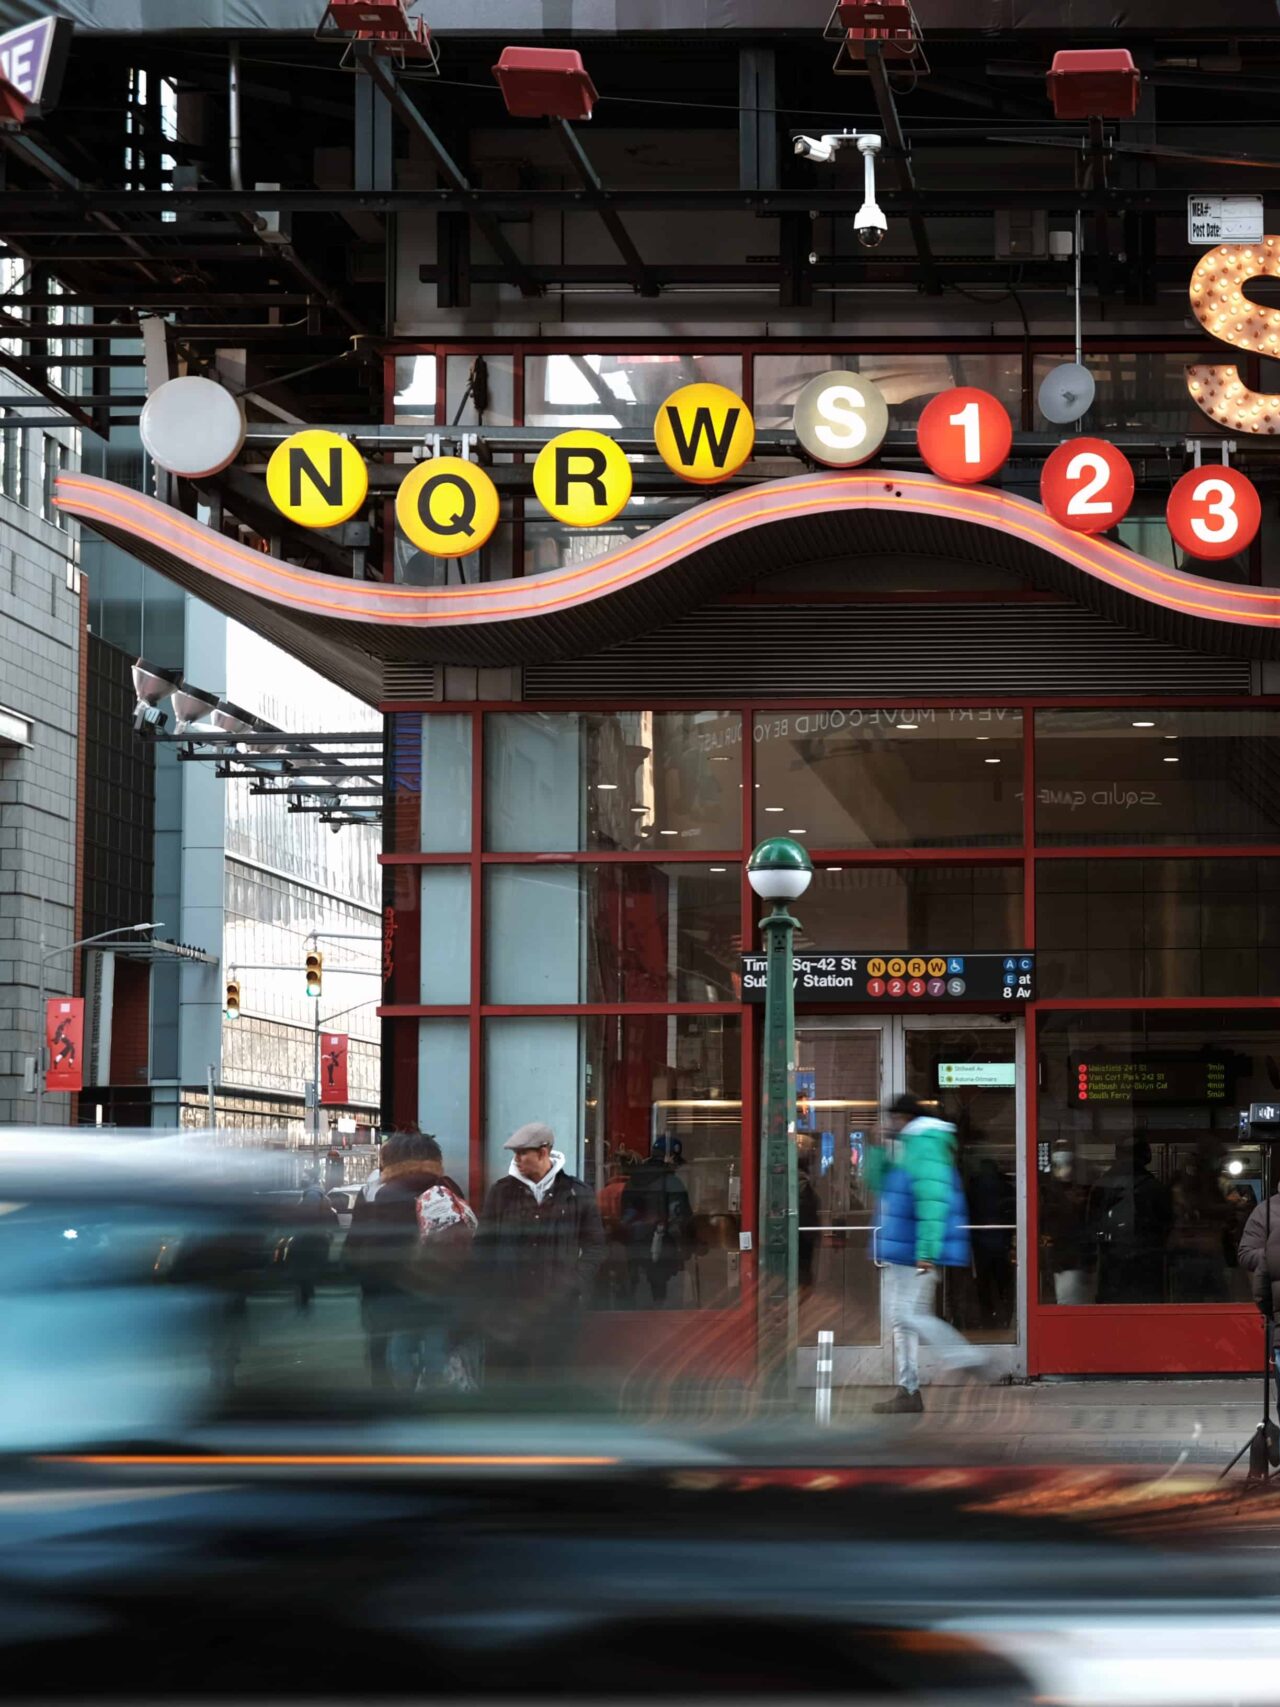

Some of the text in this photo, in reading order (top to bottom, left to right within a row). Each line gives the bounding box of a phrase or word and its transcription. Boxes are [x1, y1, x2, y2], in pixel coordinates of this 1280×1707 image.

[1193, 222, 1206, 238] Post
[1206, 222, 1221, 238] Date:
[289, 447, 343, 506] N
[417, 473, 476, 537] Q
[555, 447, 608, 506] R
[665, 405, 741, 468] W
[814, 385, 867, 449] S
[949, 402, 981, 464] 1
[1065, 452, 1113, 516] 2
[1190, 479, 1239, 543] 3
[743, 958, 857, 973] Tim Sq-42 St
[803, 974, 853, 988] Station
[1018, 974, 1031, 985] at
[1003, 987, 1031, 998] 8 Av
